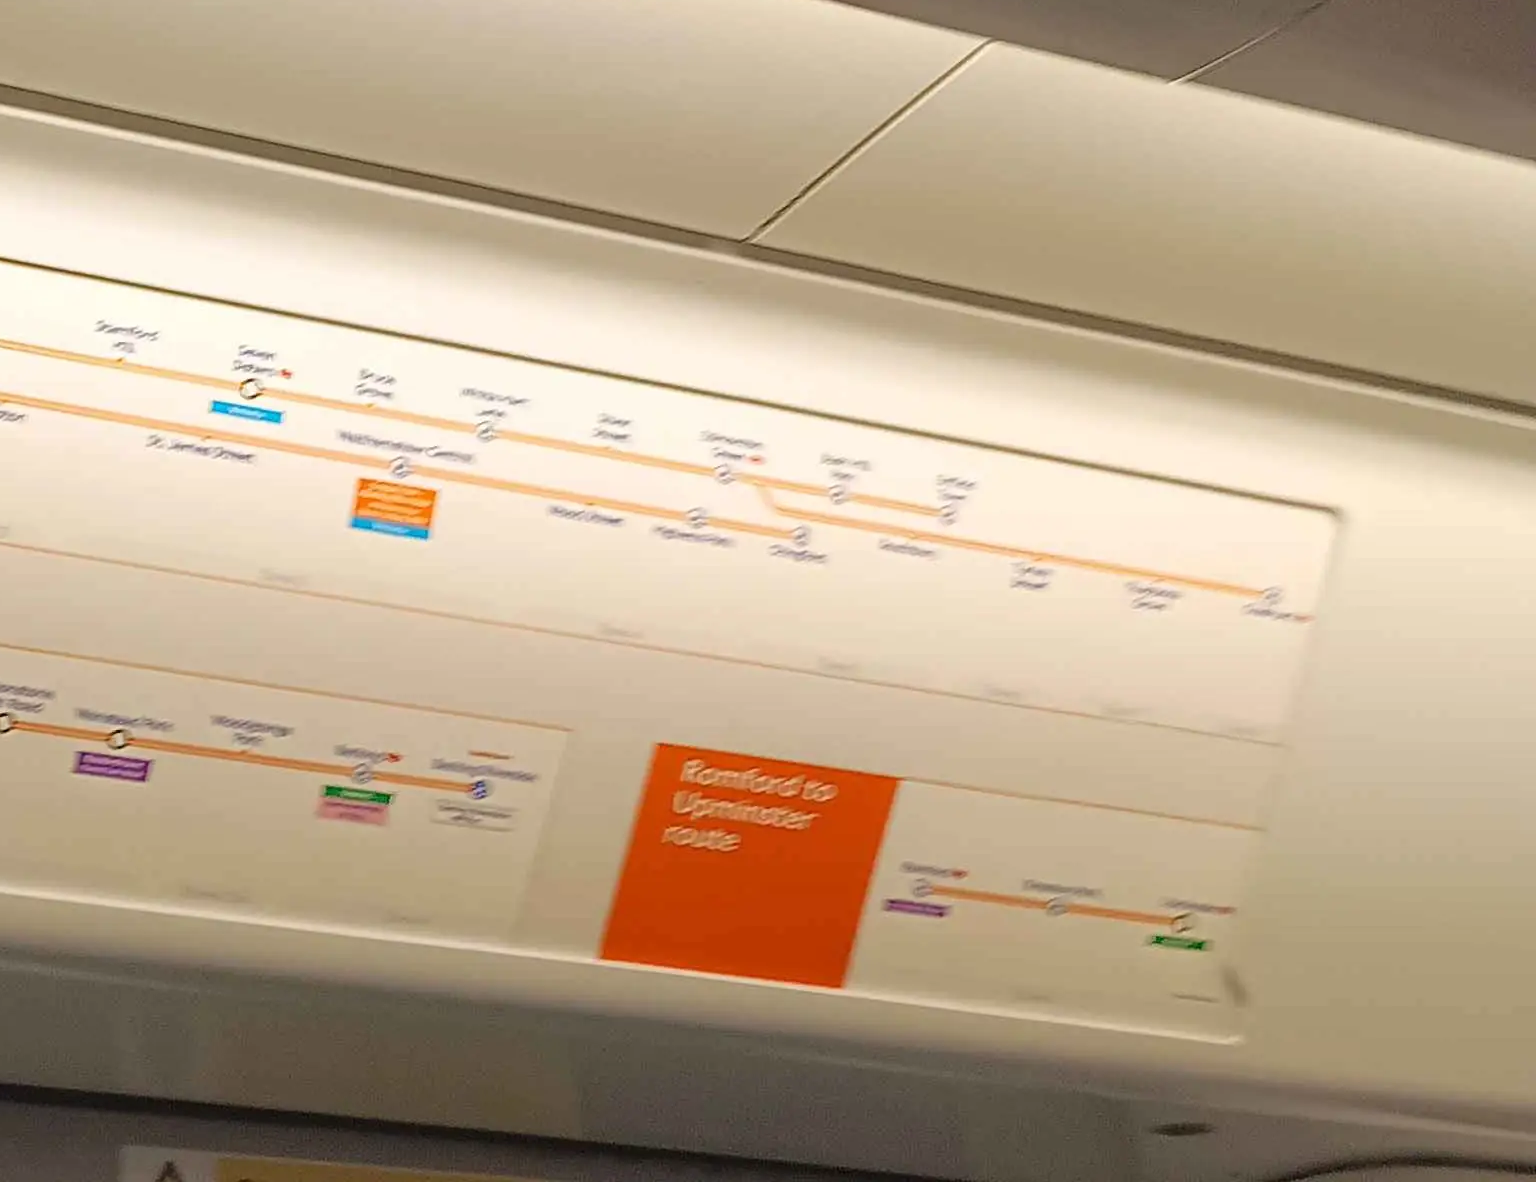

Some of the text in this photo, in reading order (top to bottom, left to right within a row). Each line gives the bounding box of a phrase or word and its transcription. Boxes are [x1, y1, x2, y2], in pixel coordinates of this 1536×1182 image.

[679, 758, 839, 802] Romford to
[660, 825, 742, 852] route
